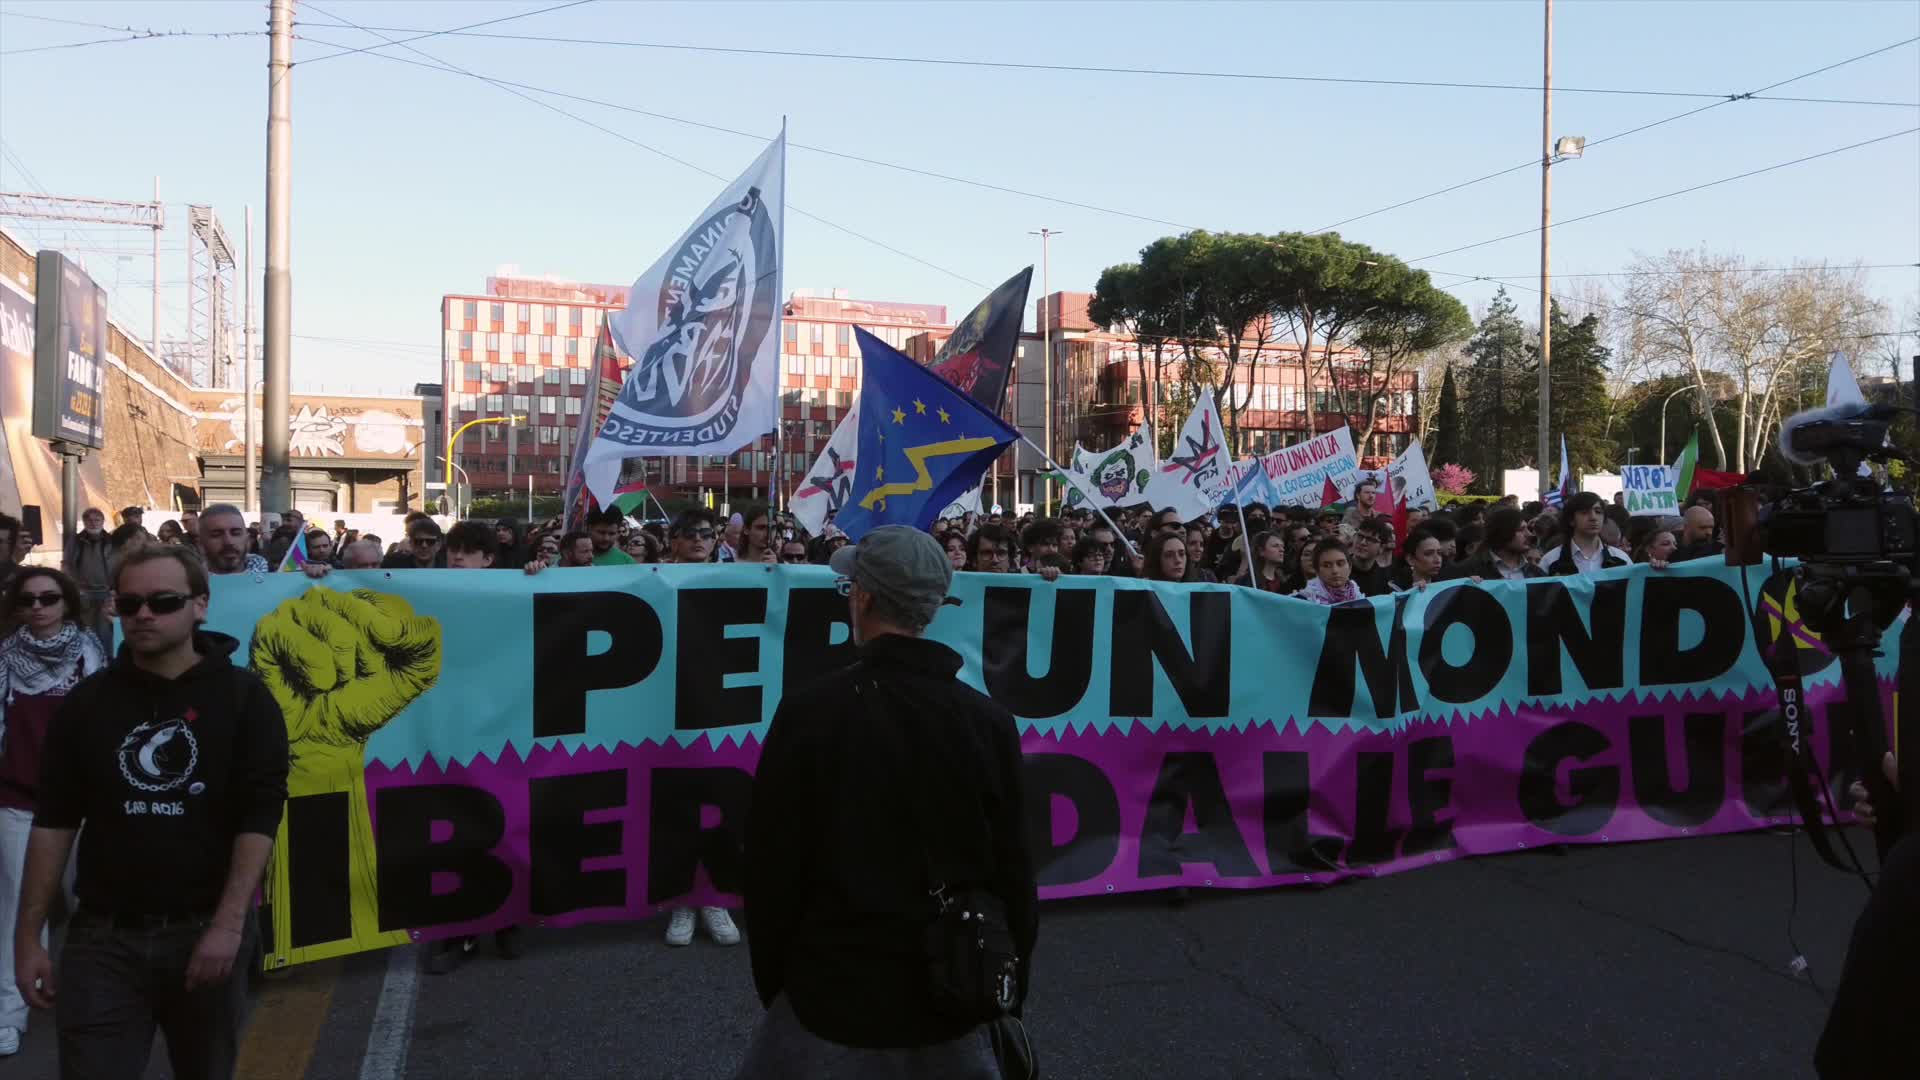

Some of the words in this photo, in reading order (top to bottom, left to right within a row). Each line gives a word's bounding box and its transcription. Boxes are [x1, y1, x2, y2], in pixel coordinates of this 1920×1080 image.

[1287, 446, 1313, 472] UNA
[1308, 434, 1341, 462] VOLTA
[983, 586, 1231, 719] UN
[1784, 687, 1799, 756] SONY
[258, 767, 750, 952] IBER
